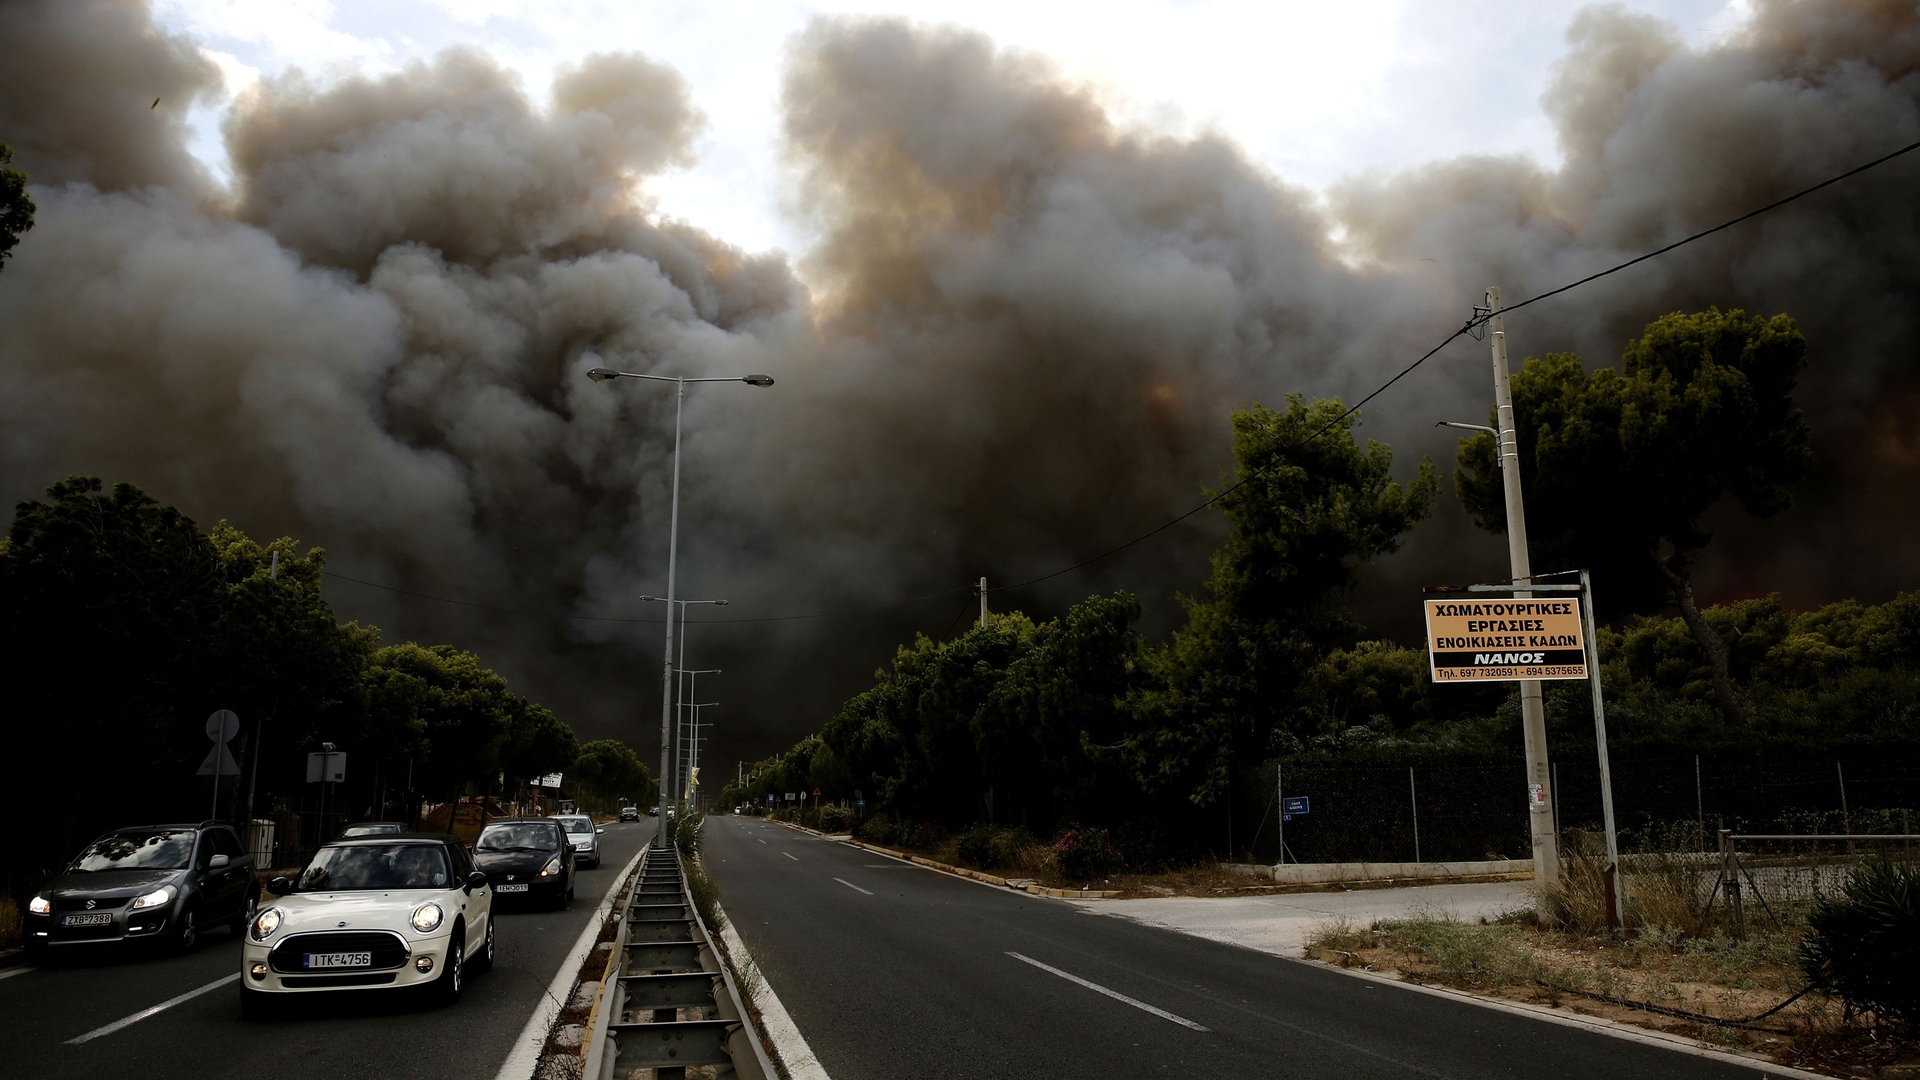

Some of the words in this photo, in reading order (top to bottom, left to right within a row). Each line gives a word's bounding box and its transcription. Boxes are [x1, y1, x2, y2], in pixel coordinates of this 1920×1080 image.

[1435, 603, 1572, 616] ΧΩΜΑΤΟΥΡΓΙΚΕΣ
[1467, 620, 1544, 632] ΕΡΓΑΣΙΕΣ
[1436, 636, 1526, 648] ΕΝΟΙΚΙΑΣΕΙΣ
[1530, 635, 1577, 647] ΚΑΔΩΝ
[1474, 653, 1545, 665] ΝΑΝΟΣ
[1437, 669, 1458, 680] Τηλ.
[1460, 669, 1476, 678] 697
[1479, 668, 1518, 677] 7320591
[1526, 667, 1543, 676] 694
[1545, 666, 1584, 675] 5375655
